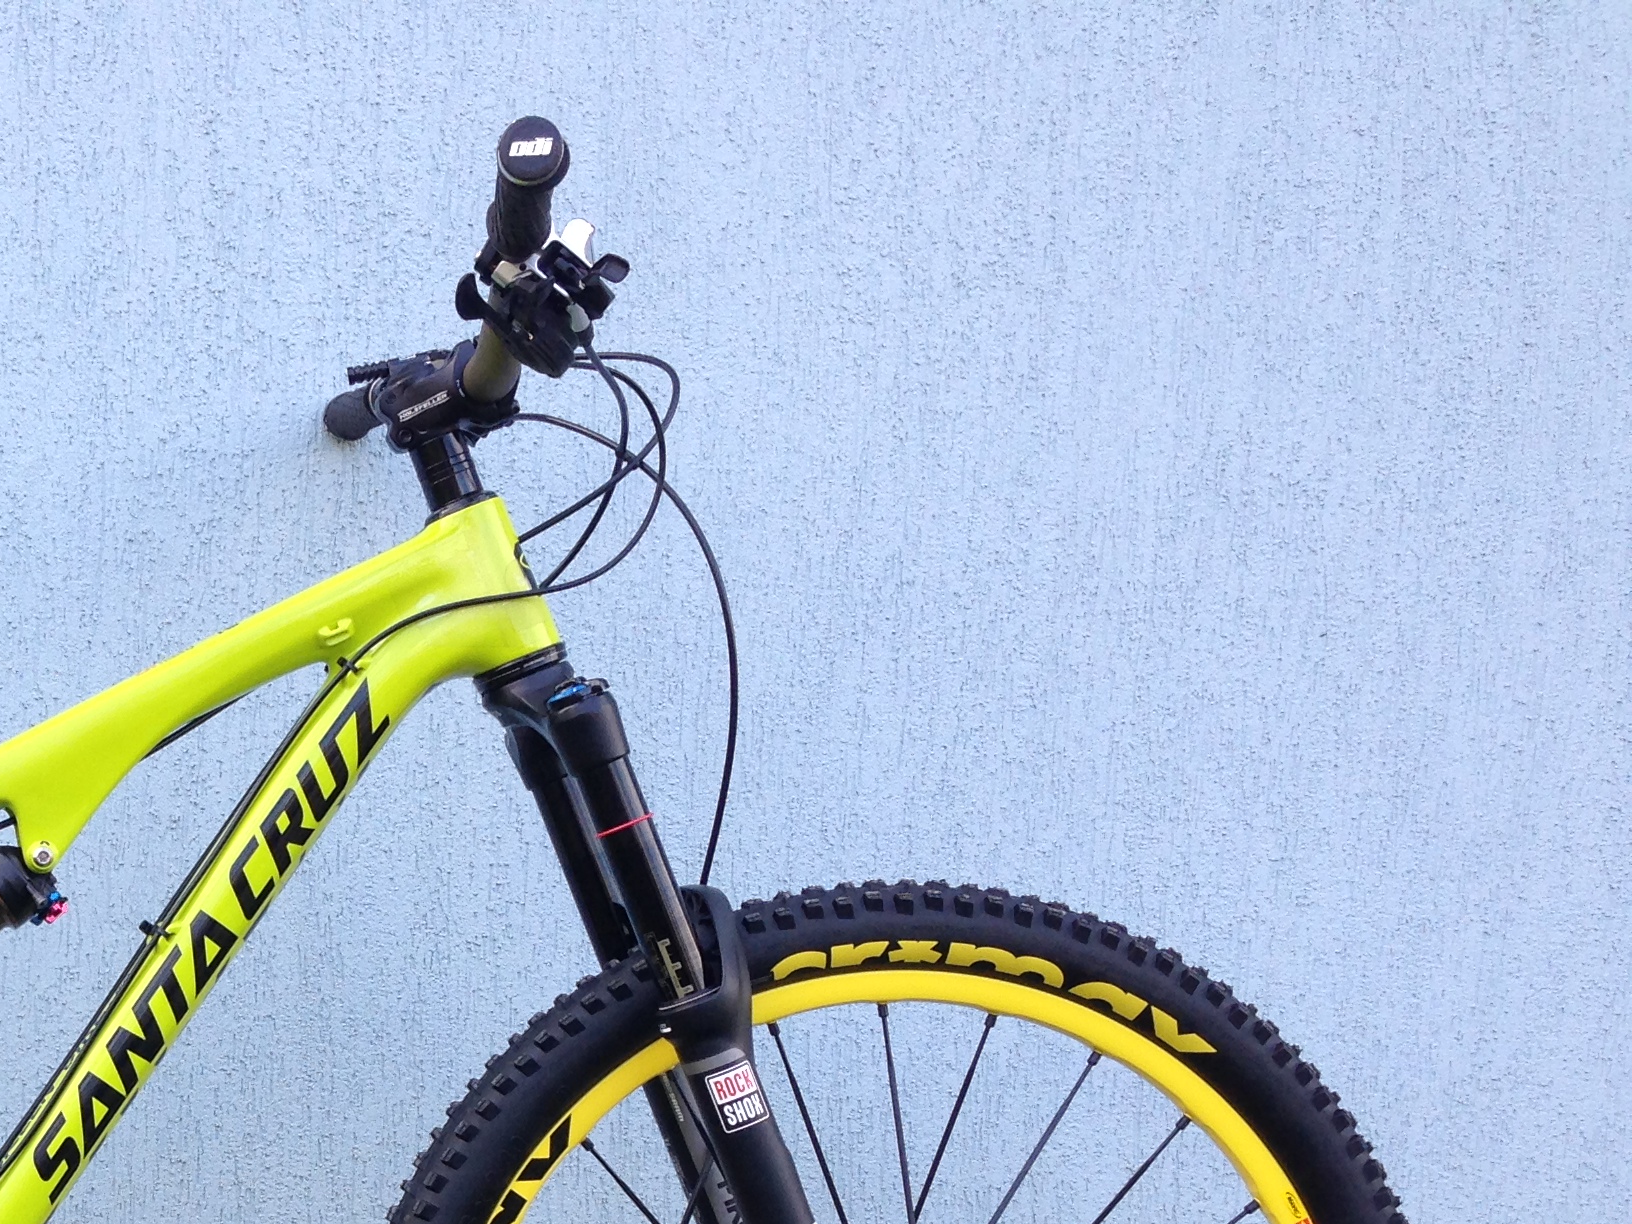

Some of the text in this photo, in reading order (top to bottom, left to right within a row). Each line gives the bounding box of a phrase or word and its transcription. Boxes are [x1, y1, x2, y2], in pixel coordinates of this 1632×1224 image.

[508, 137, 553, 157] odi
[32, 677, 392, 1205] SANTA CRUZ
[712, 1068, 755, 1102] ROCK
[723, 1092, 766, 1126] SHOX
